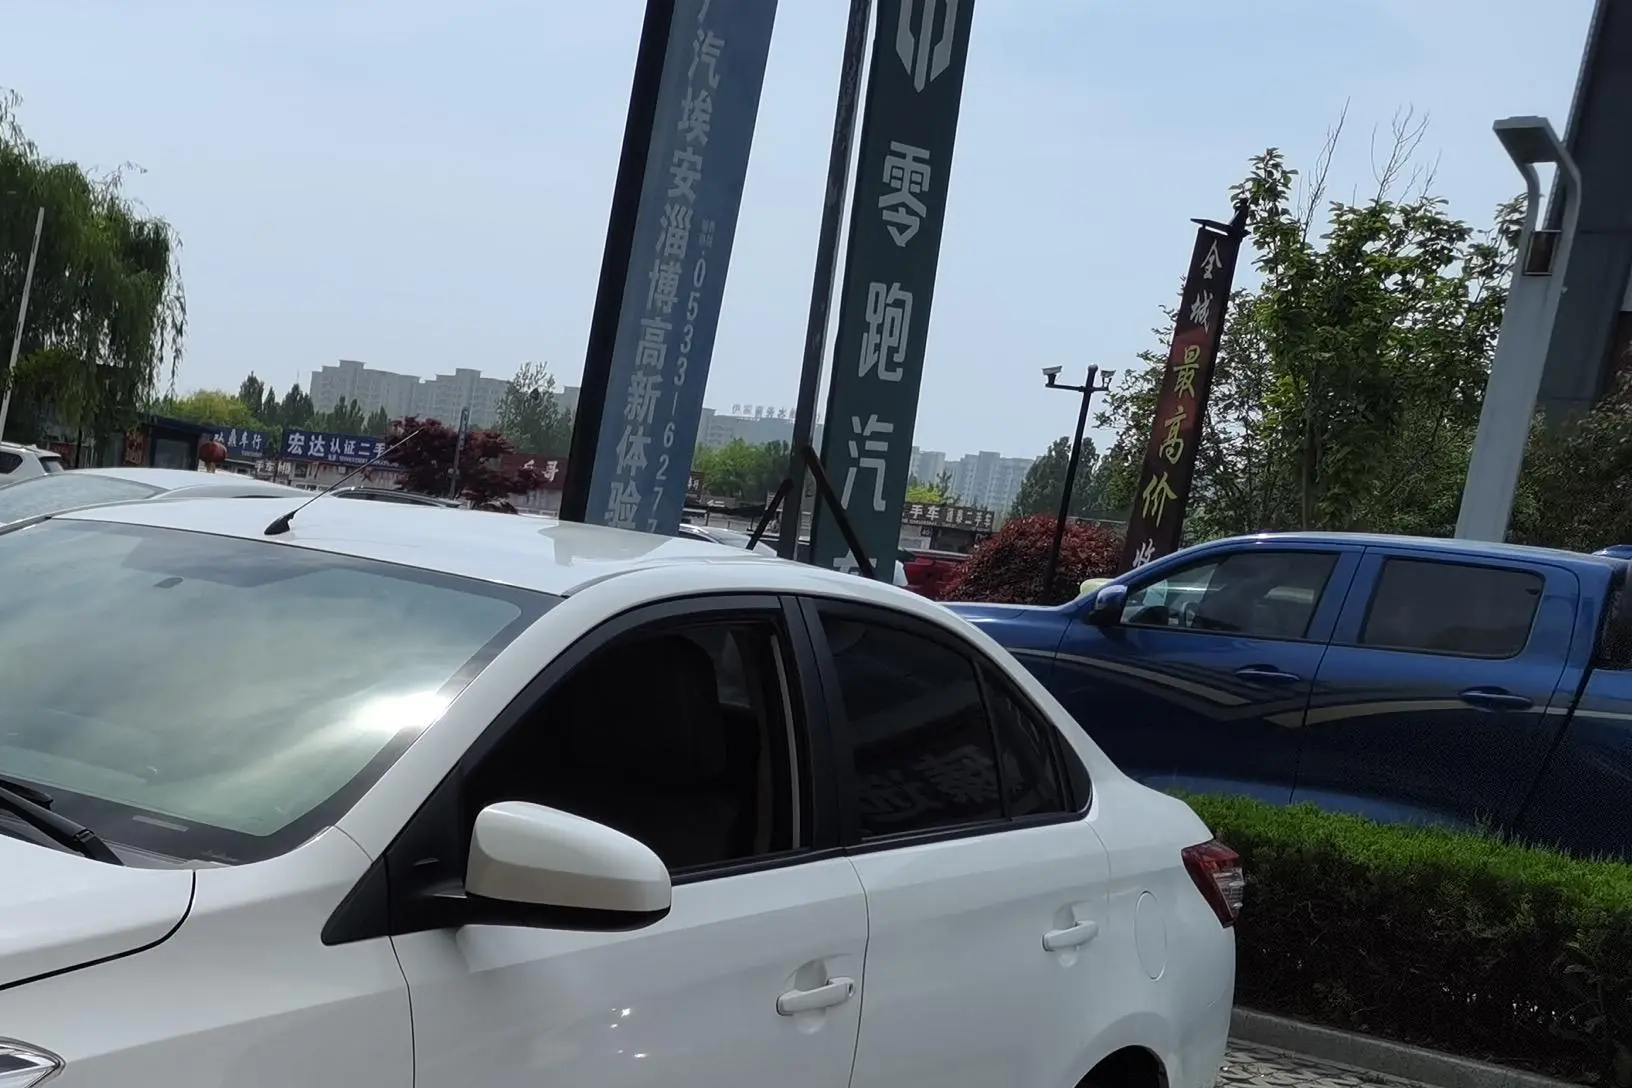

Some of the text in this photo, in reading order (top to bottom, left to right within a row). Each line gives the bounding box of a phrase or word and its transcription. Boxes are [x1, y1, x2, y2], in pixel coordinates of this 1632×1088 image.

[605, 0, 725, 529] 汽埃安淄博高新体验
[833, 141, 932, 577] 零跑汽
[1132, 238, 1223, 568] 全城最高价收
